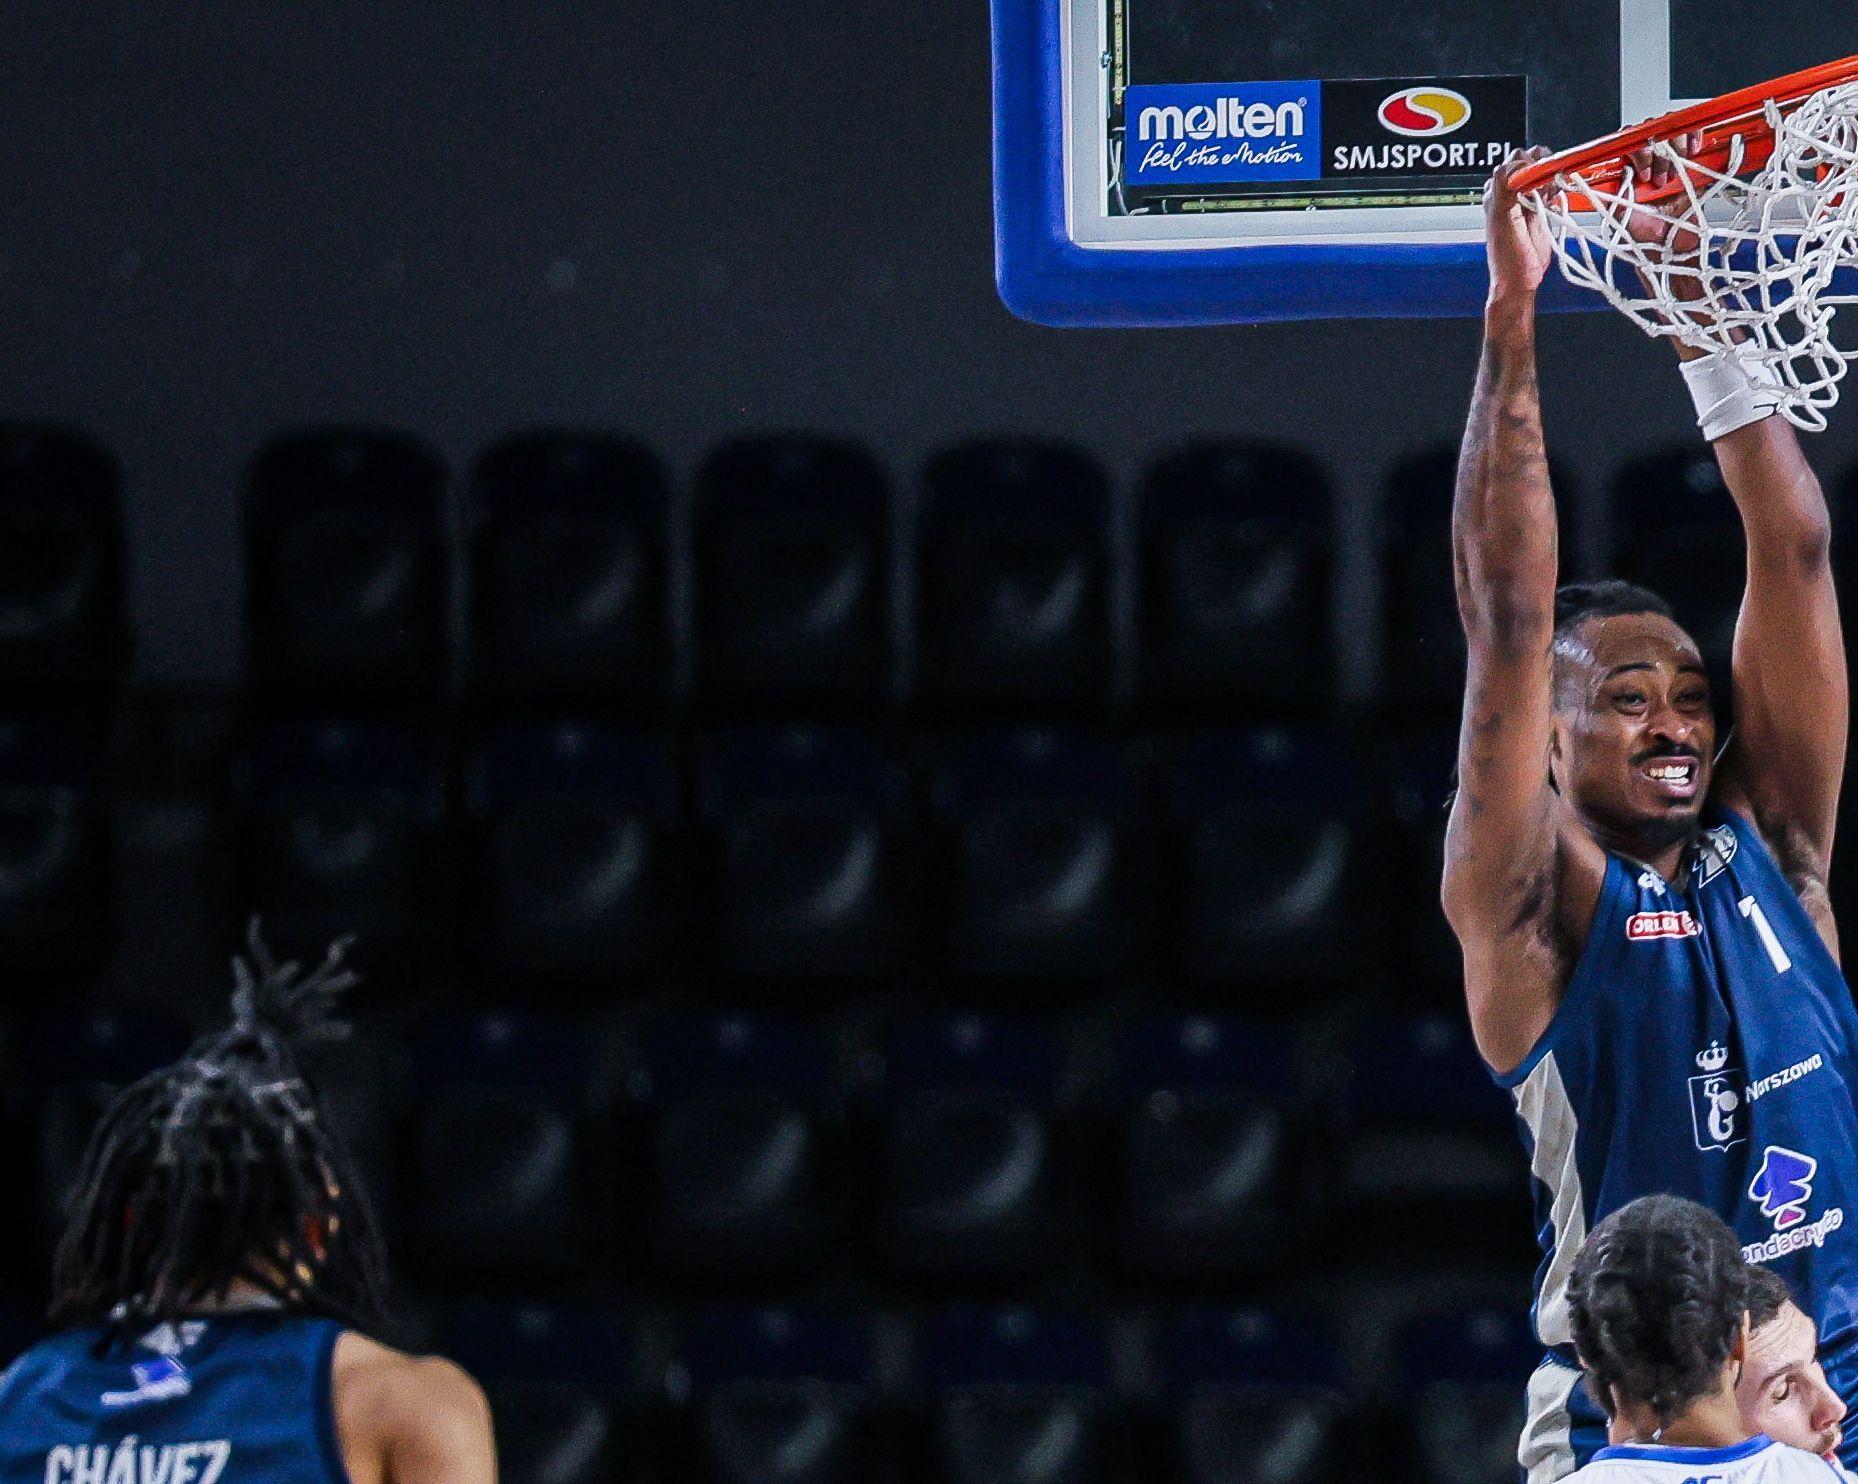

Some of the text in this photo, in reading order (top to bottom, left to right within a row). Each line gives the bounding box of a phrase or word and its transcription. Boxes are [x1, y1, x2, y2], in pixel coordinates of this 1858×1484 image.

[1138, 97, 1304, 141] molten
[1138, 141, 1188, 173] feel
[1184, 144, 1222, 166] the
[1633, 916, 1680, 934] ORLEN
[1737, 895, 1792, 974] 1
[44, 1433, 231, 1484] CHÁVEZ
